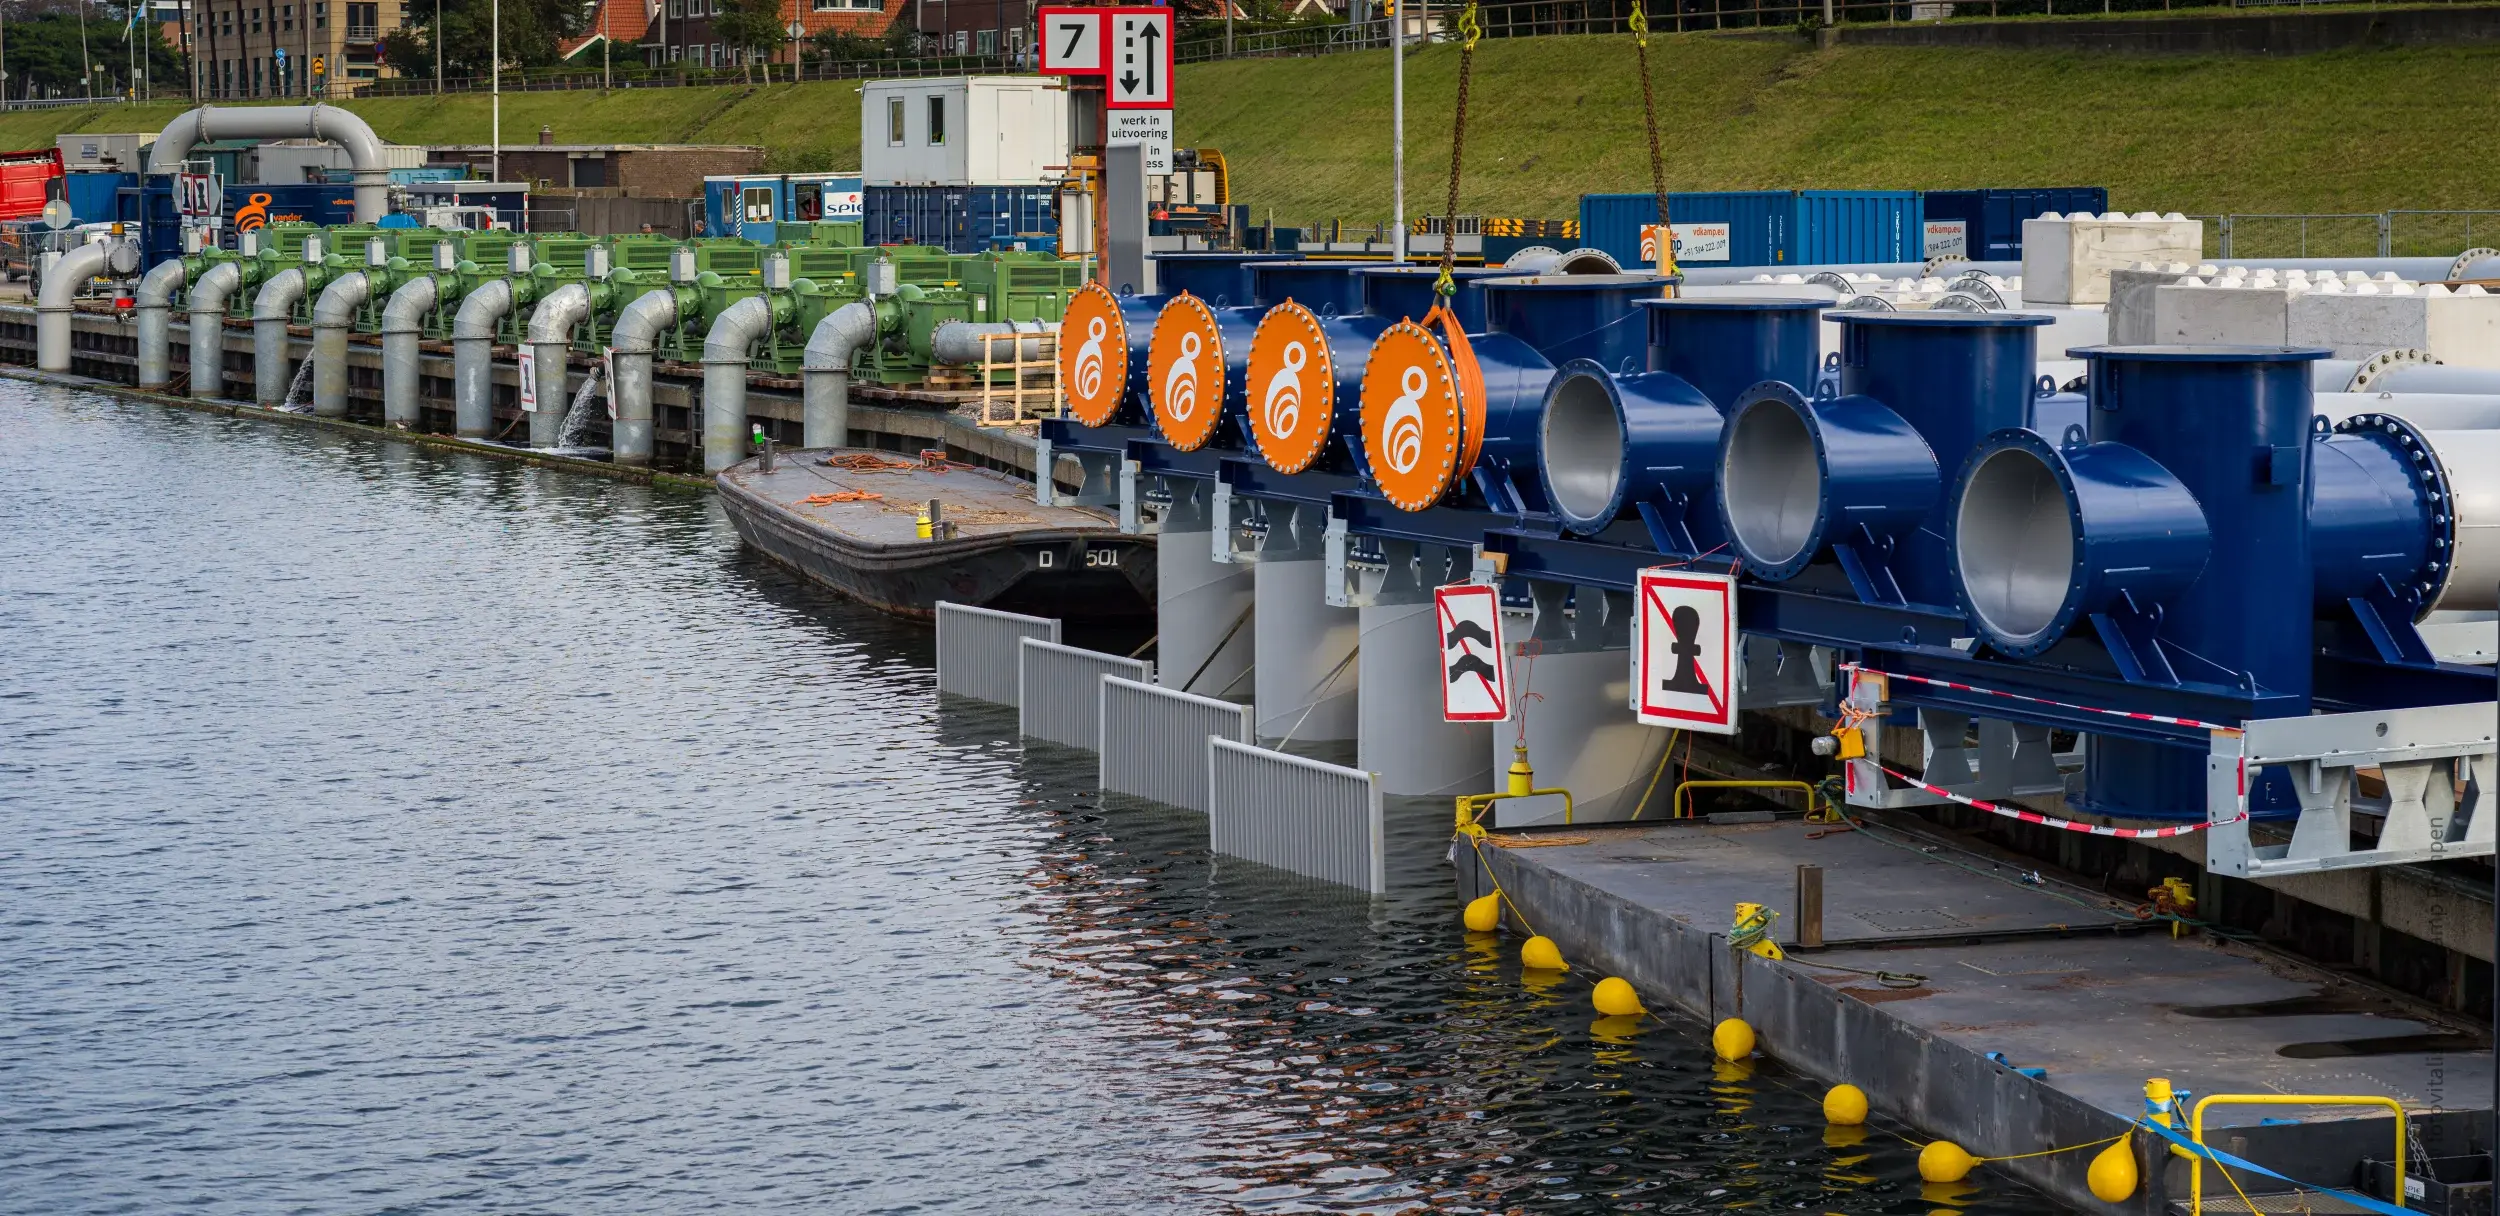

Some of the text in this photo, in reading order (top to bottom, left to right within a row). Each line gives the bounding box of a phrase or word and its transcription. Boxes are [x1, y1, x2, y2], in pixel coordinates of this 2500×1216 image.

[1060, 24, 1085, 58] 7
[1121, 116, 1159, 125] werk in
[1112, 129, 1167, 139] uitvoering
[1151, 146, 1159, 155] in
[273, 212, 303, 221] vander
[1693, 227, 1725, 237] vdkamp.eu
[1927, 225, 1961, 235] vdkamp.eu
[1705, 242, 1715, 252] 222
[1940, 240, 1951, 249] 222
[1952, 237, 1963, 247] 009
[1039, 549, 1118, 567] D 501
